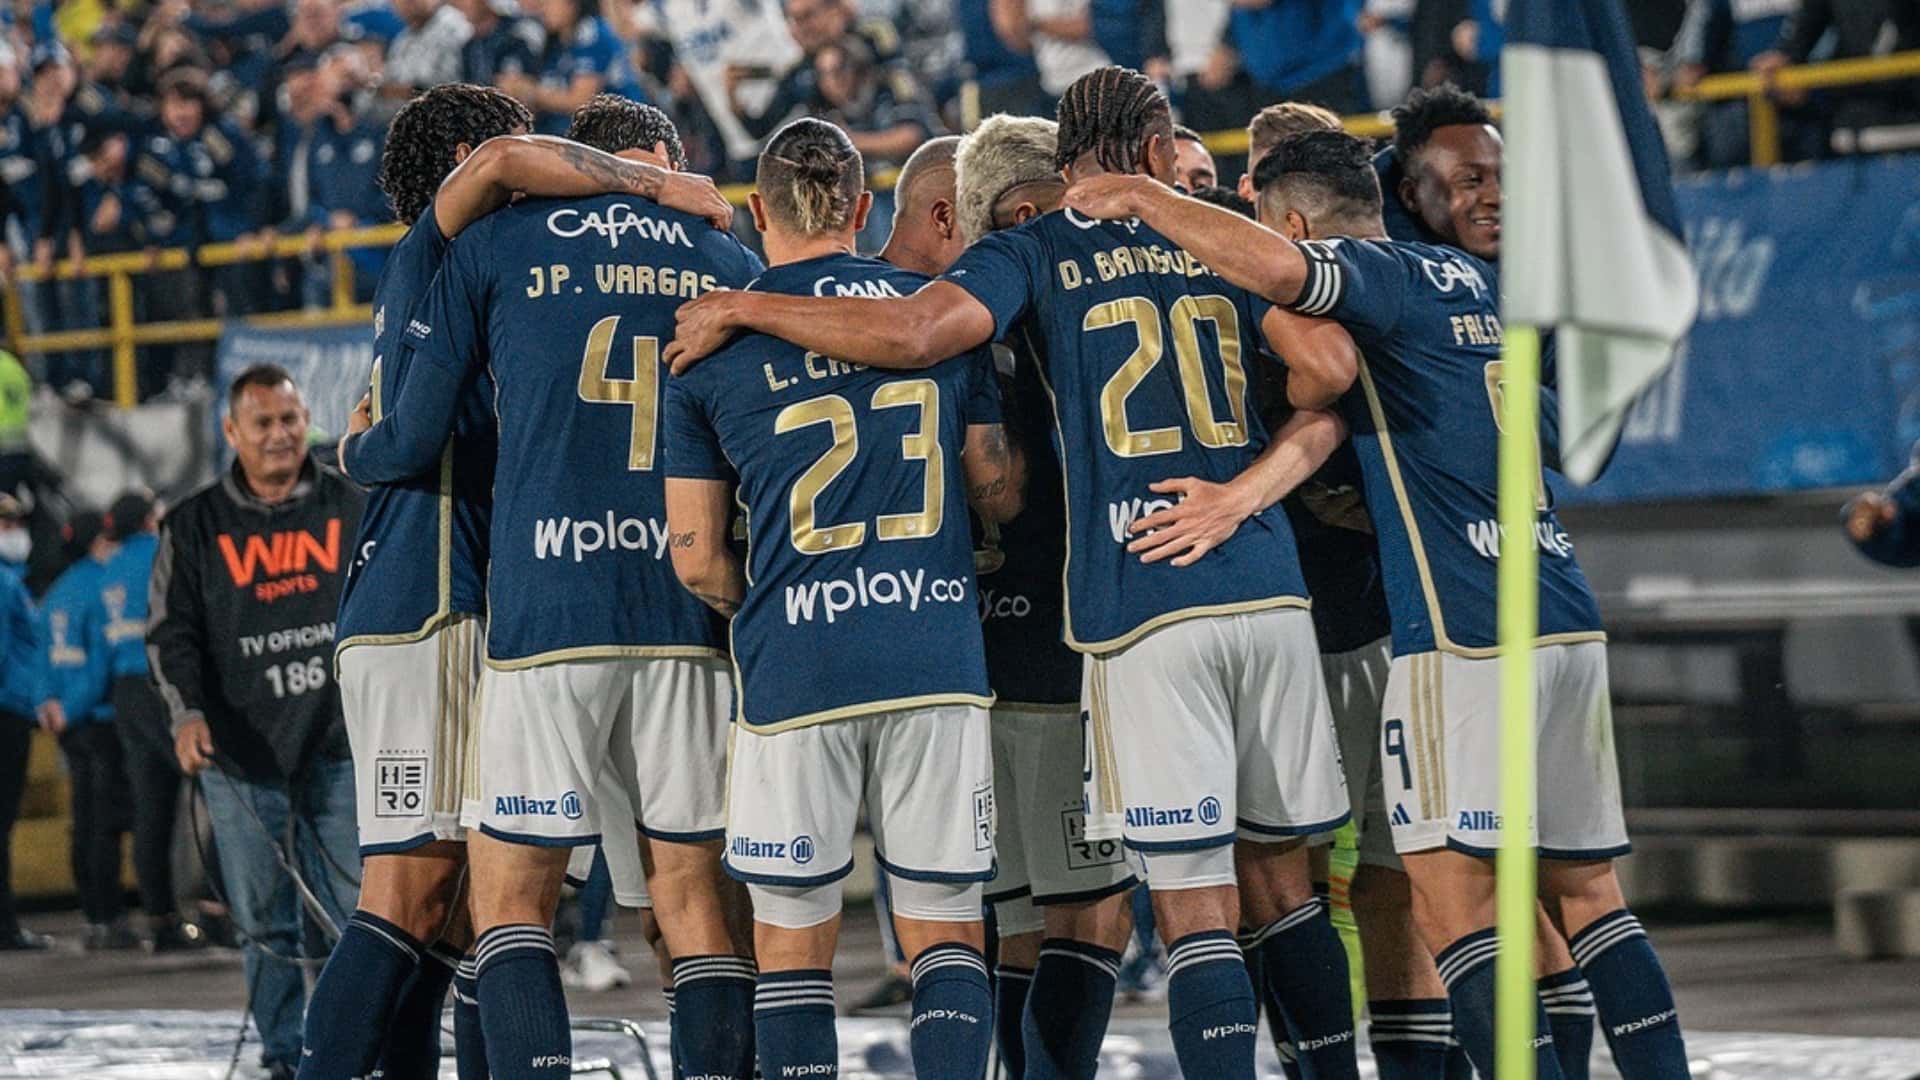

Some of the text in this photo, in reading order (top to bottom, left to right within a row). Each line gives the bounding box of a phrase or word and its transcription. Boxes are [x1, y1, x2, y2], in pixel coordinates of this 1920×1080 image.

[526, 264, 583, 298] JP.
[1058, 259, 1093, 290] D.
[763, 362, 799, 392] L.
[1083, 295, 1250, 457] 20
[577, 315, 658, 470] 4
[774, 378, 944, 555] 23
[217, 518, 342, 588] WIN
[255, 574, 319, 603] sports
[240, 634, 264, 656] TV
[265, 656, 326, 698] 186
[1385, 718, 1412, 790] 9
[495, 796, 557, 815] Allianz
[1125, 806, 1194, 827] Allianz
[731, 837, 785, 858] Allianz
